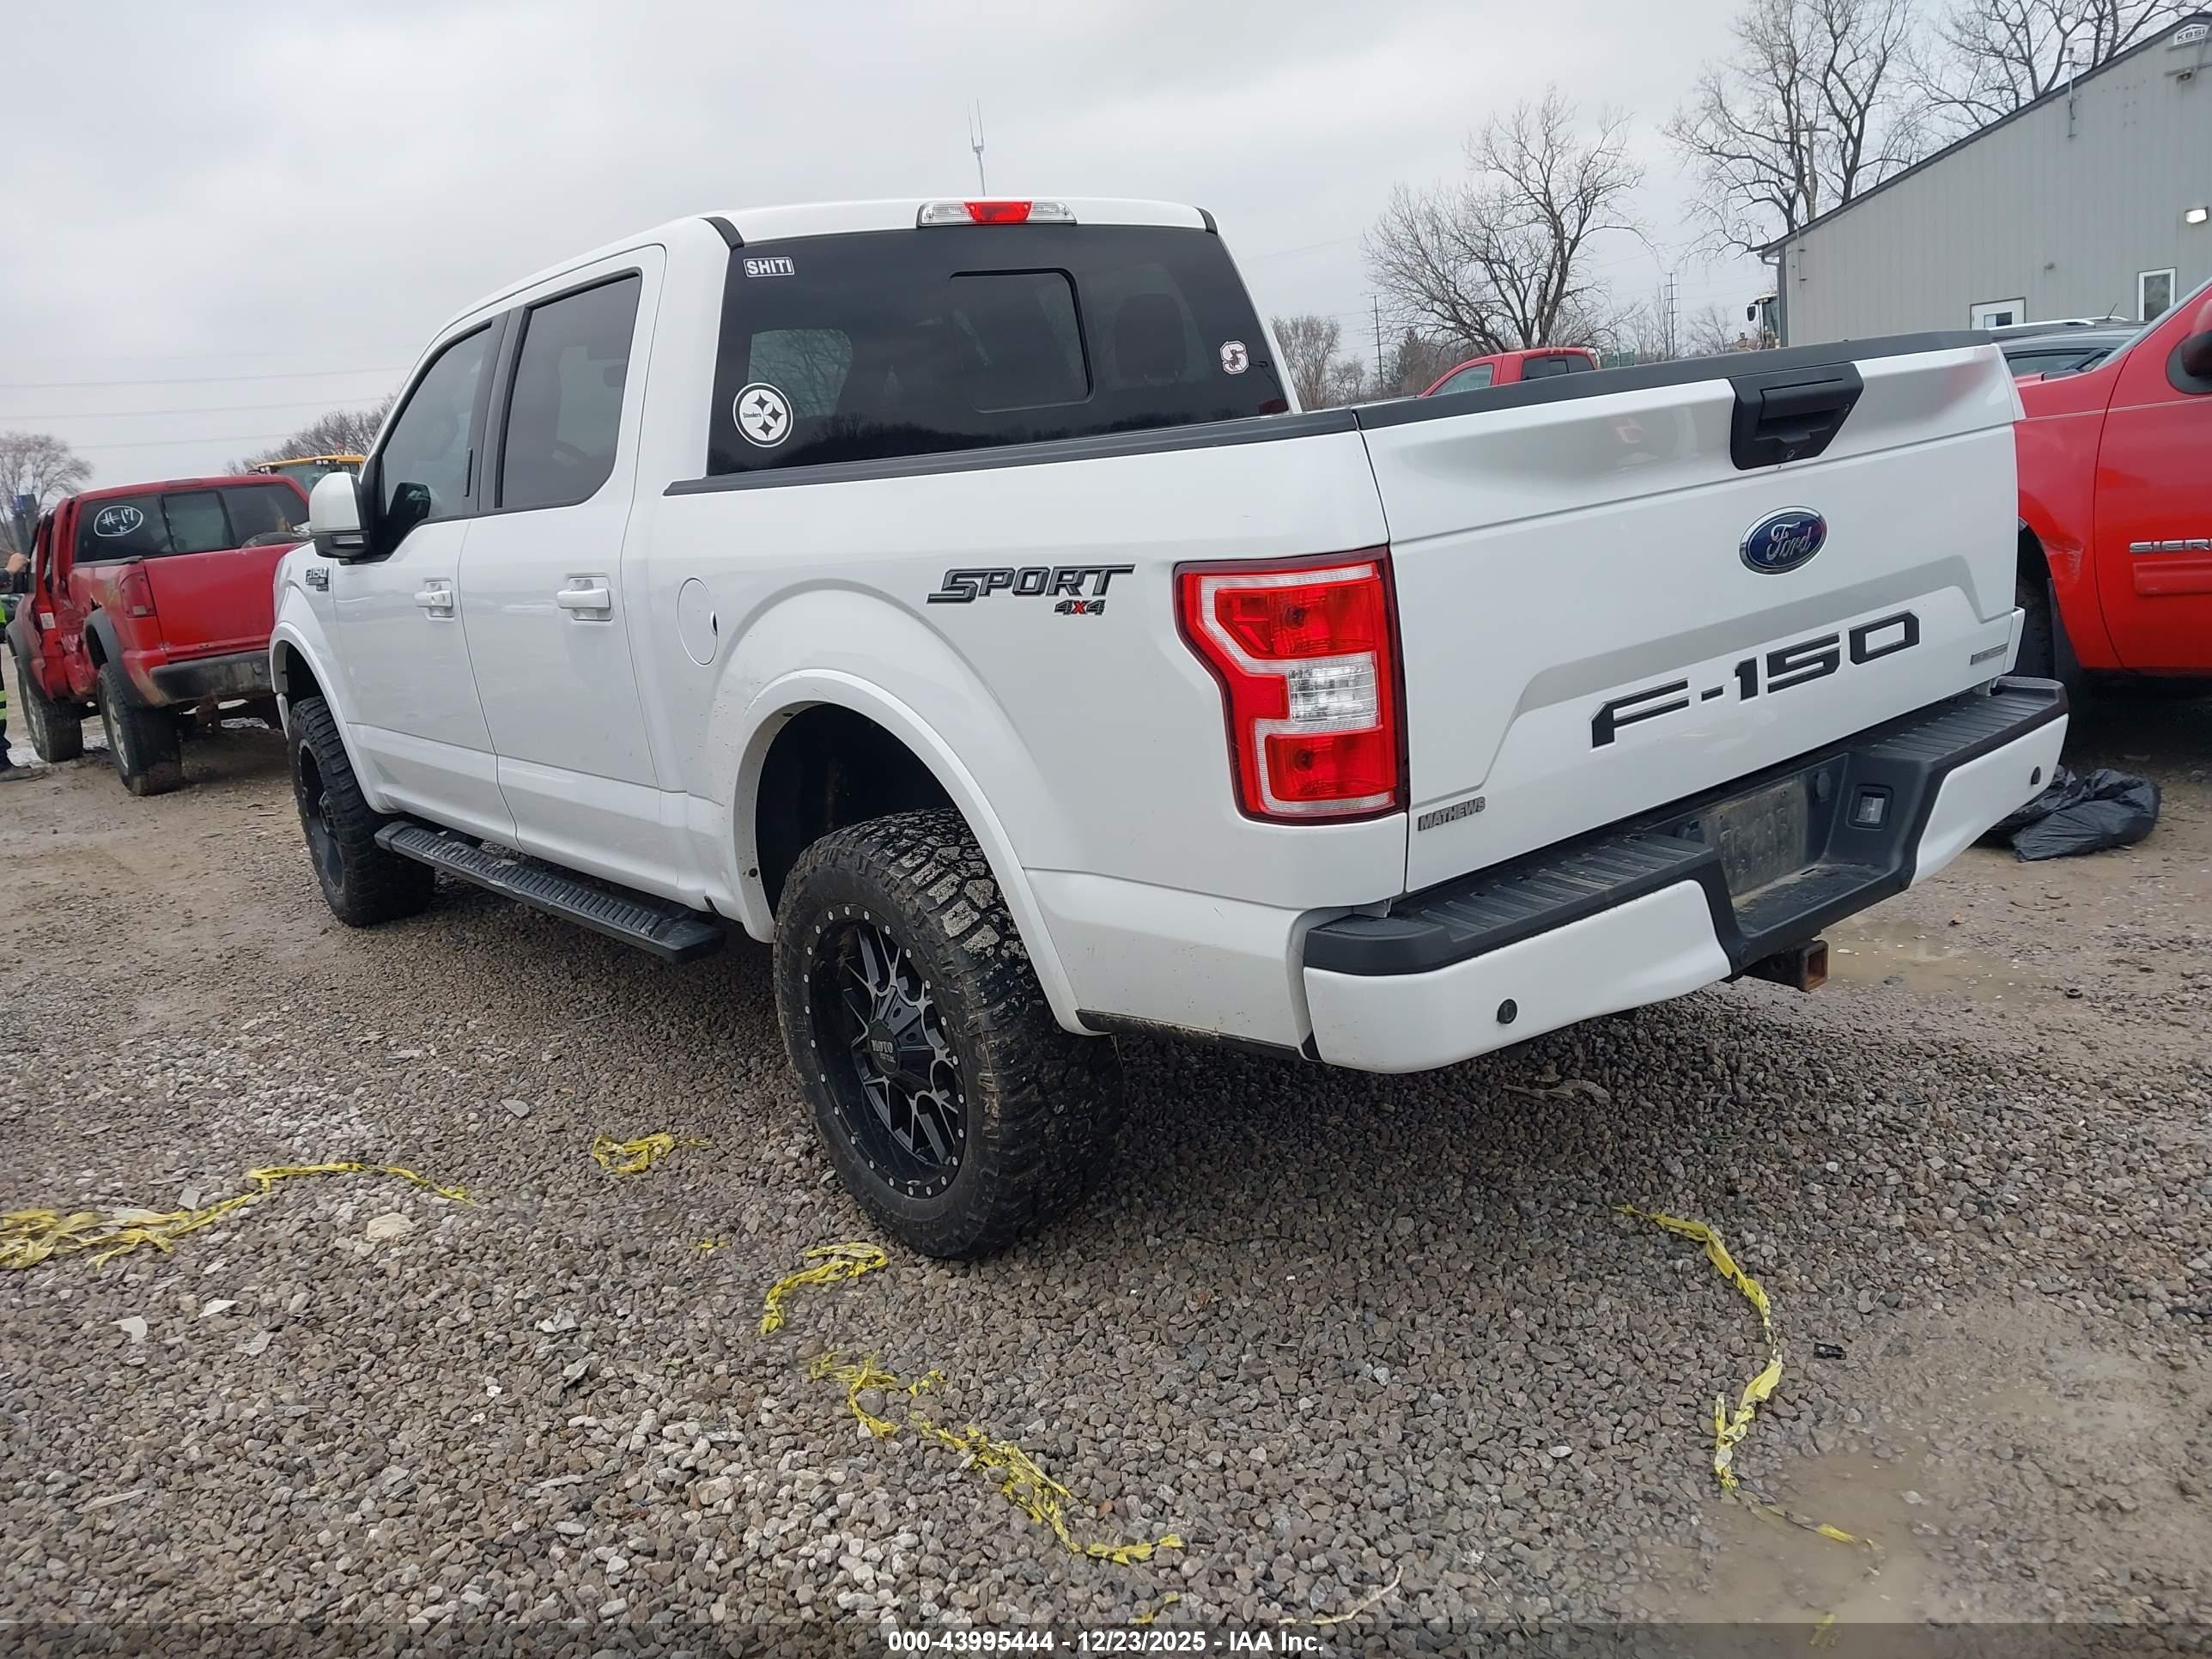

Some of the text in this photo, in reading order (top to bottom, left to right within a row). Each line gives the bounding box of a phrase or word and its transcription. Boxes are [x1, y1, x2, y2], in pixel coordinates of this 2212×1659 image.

[746, 259, 793, 275] SHITI
[1765, 520, 1812, 561] Ford
[2129, 538, 2212, 554] SIER
[927, 563, 1136, 605] SPORT
[1590, 608, 1921, 750] F-150
[1418, 796, 1486, 832] MATHEWS
